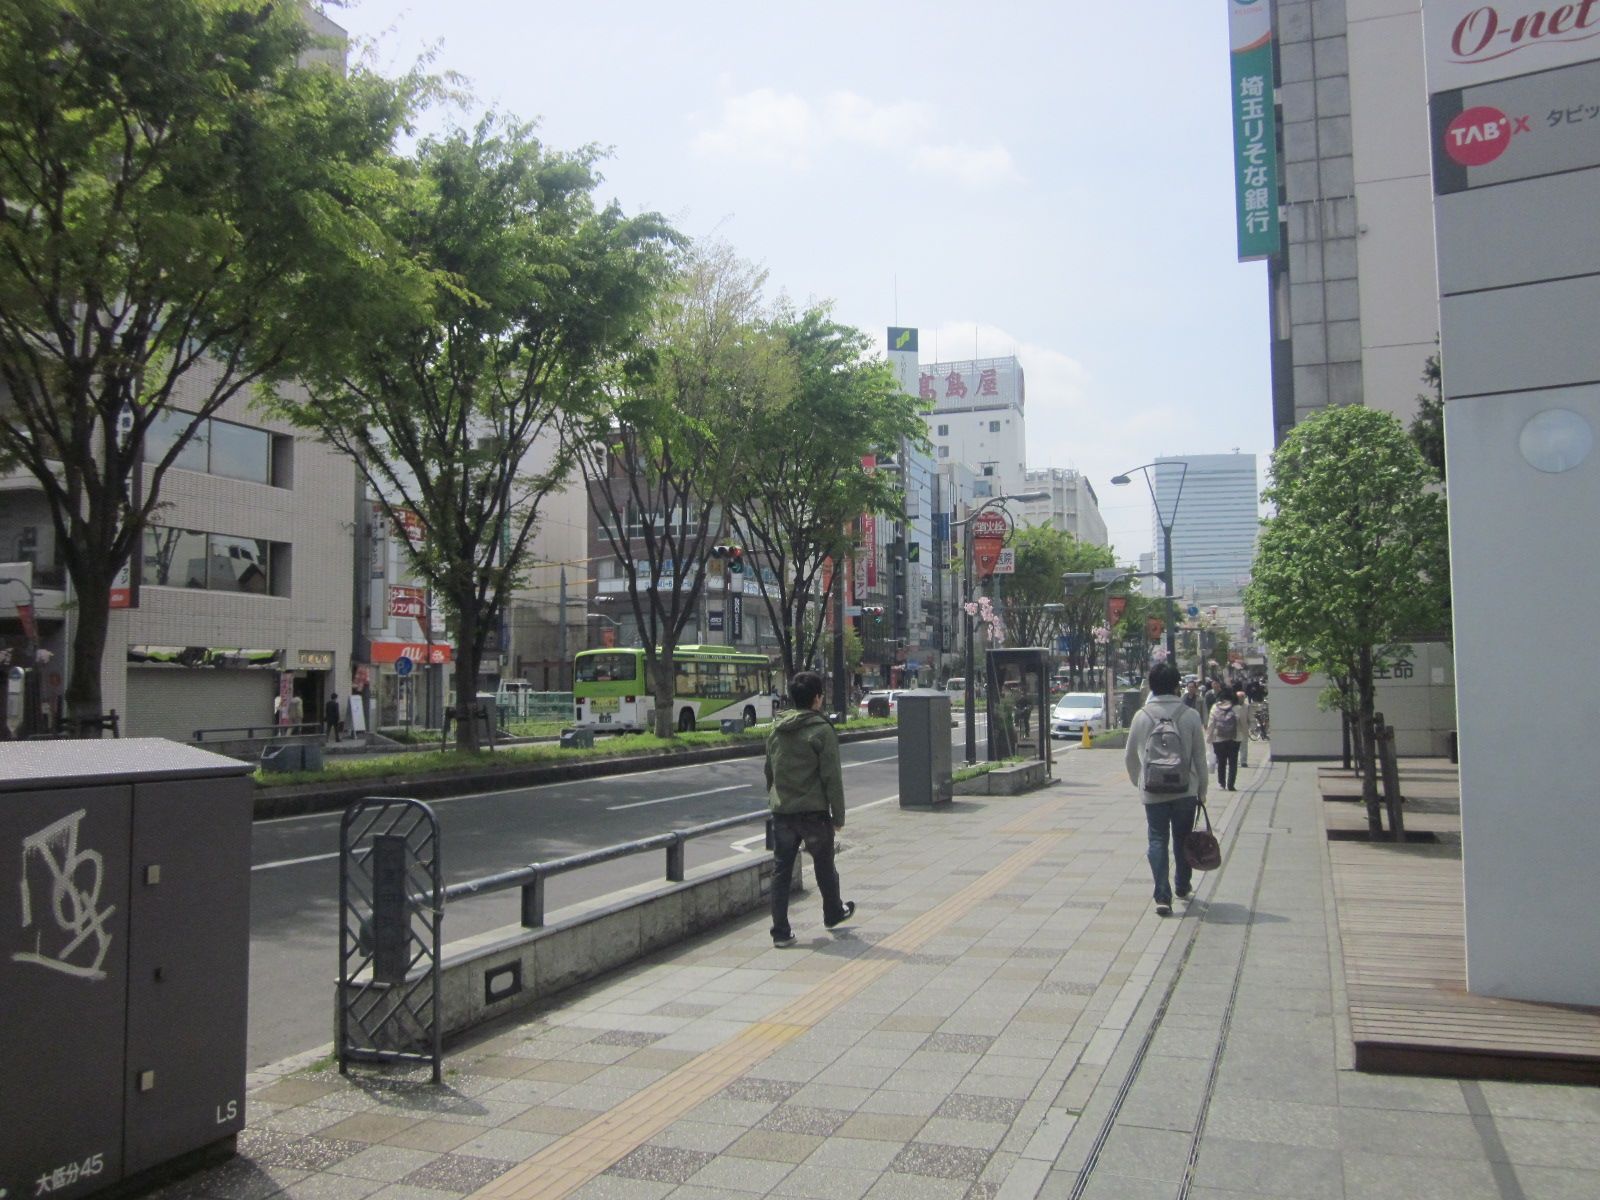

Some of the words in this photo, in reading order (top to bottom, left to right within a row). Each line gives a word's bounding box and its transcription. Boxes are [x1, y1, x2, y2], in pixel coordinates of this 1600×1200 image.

[1240, 75, 1269, 233] 埼玉りそな銀行
[918, 368, 999, 399] 高島屋
[216, 1100, 237, 1124] LS
